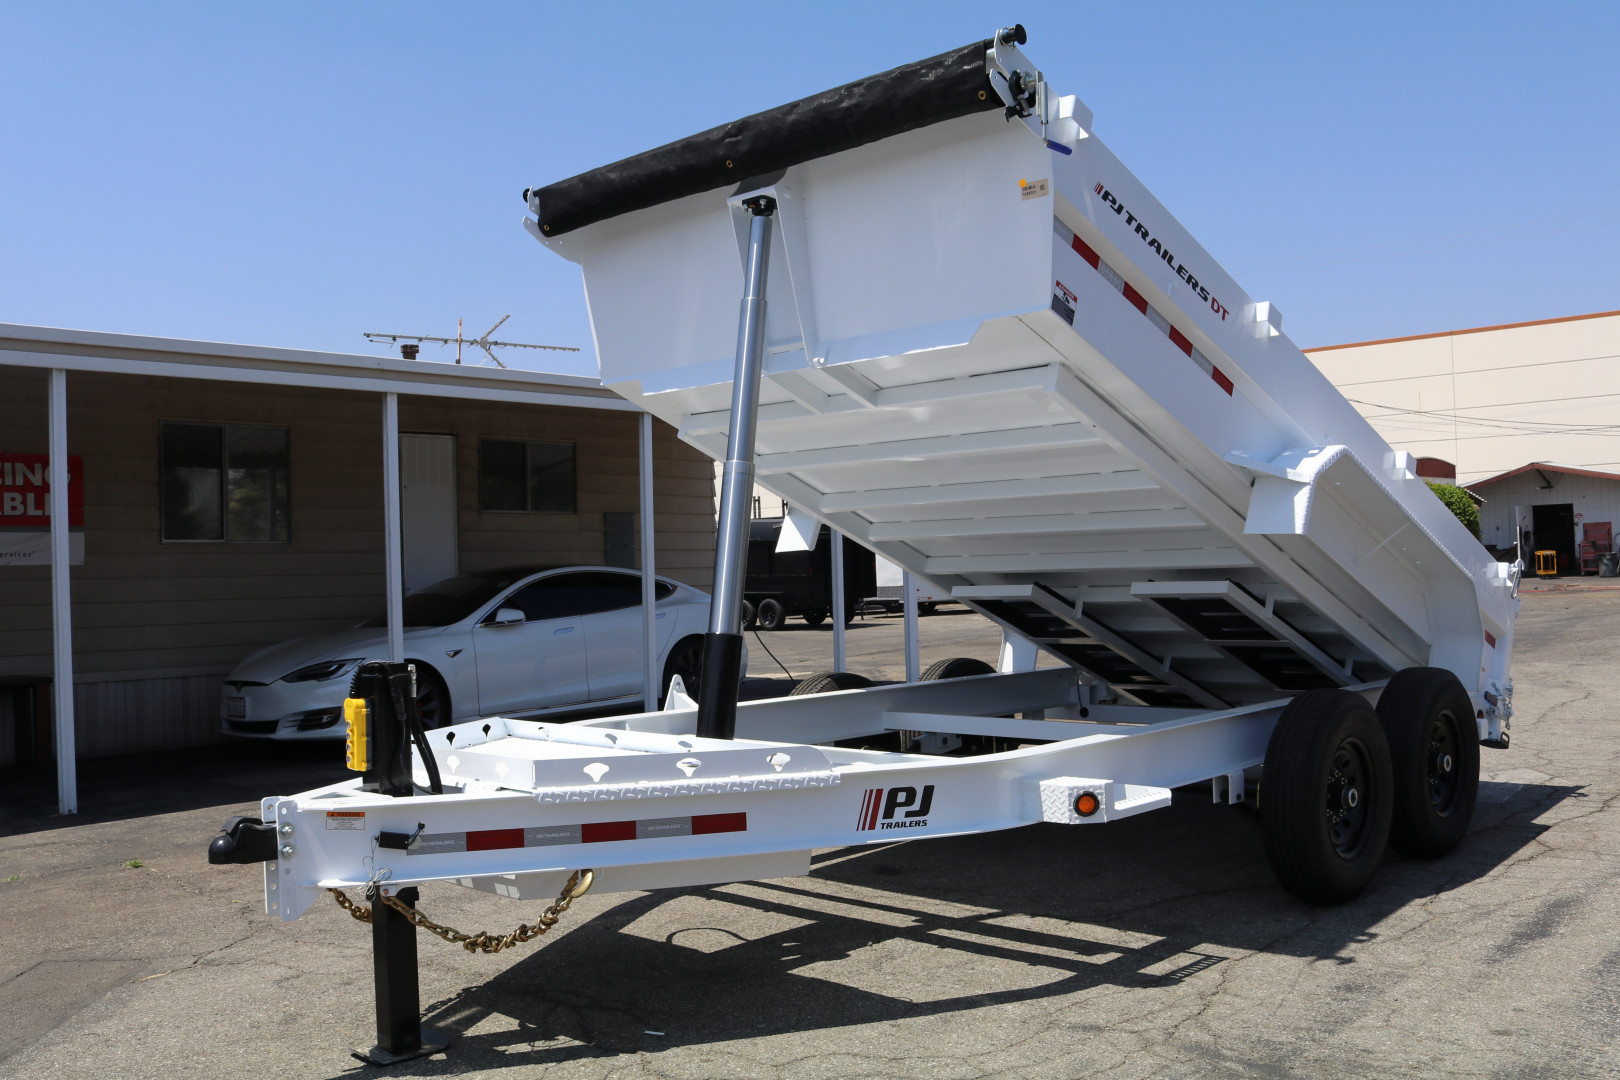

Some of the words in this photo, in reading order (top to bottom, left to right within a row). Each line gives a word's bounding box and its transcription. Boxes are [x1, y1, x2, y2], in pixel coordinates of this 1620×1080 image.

[1101, 190, 1124, 215] PJ
[1125, 210, 1210, 302] TRAILERS
[1211, 296, 1230, 321] DT
[882, 785, 934, 819] PJ
[881, 820, 928, 830] TRAILERS
